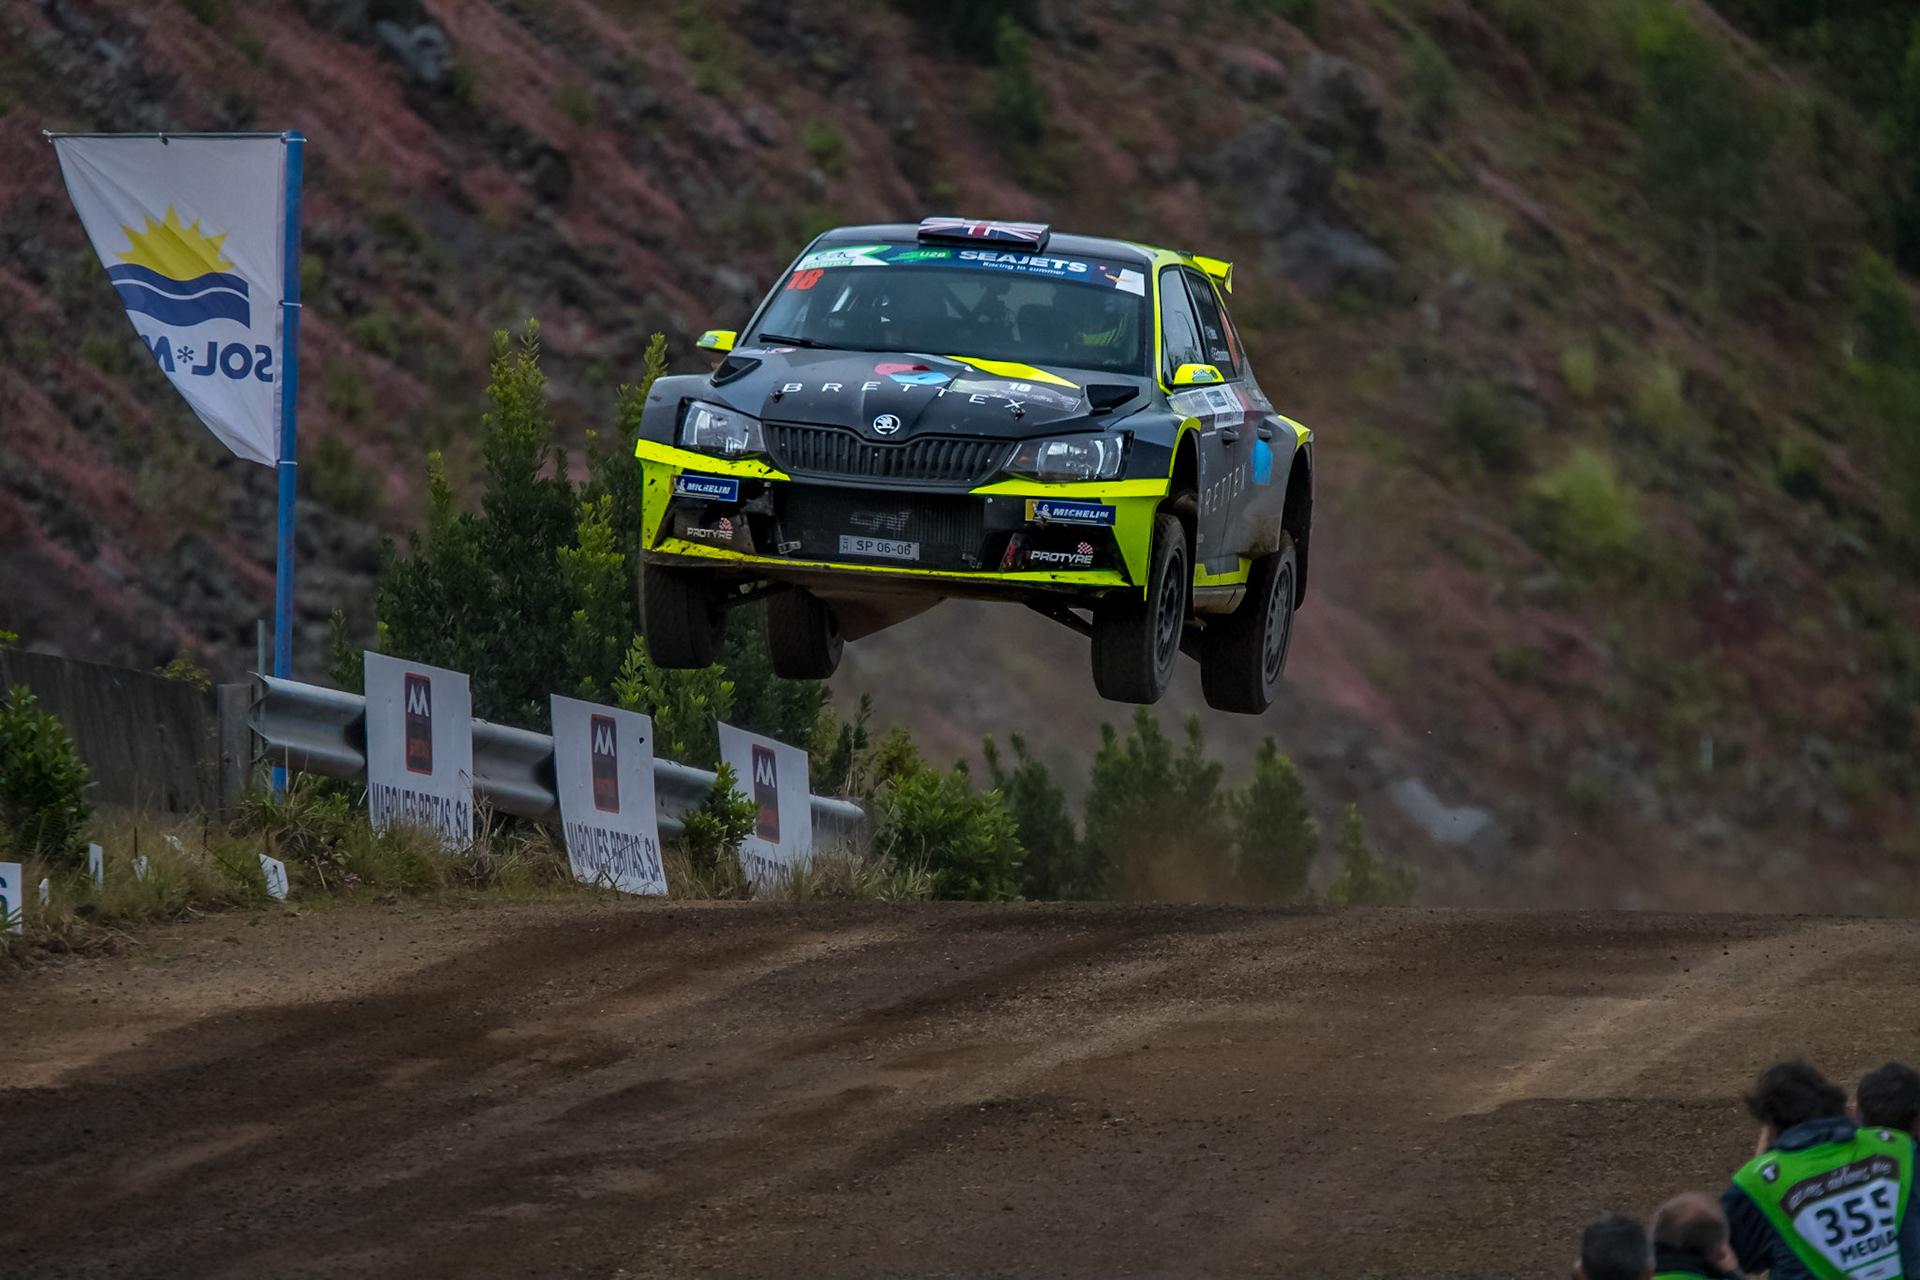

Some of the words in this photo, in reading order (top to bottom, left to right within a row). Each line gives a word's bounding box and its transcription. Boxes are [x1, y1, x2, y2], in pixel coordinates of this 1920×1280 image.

[958, 250, 1087, 273] SEAJETS
[786, 269, 824, 290] 18
[1028, 267, 1066, 276] summer
[782, 381, 1026, 409] BRETTEX
[686, 481, 732, 495] MICHELIN
[1052, 507, 1109, 519] MICHELIN
[687, 527, 734, 540] PROTYRE
[856, 540, 874, 552] SP
[876, 542, 911, 556] 06-06
[1029, 550, 1093, 565] PROTYRE
[566, 821, 612, 874] MARQUES
[644, 837, 664, 882] SA
[1839, 1230, 1898, 1265] MEDIA
